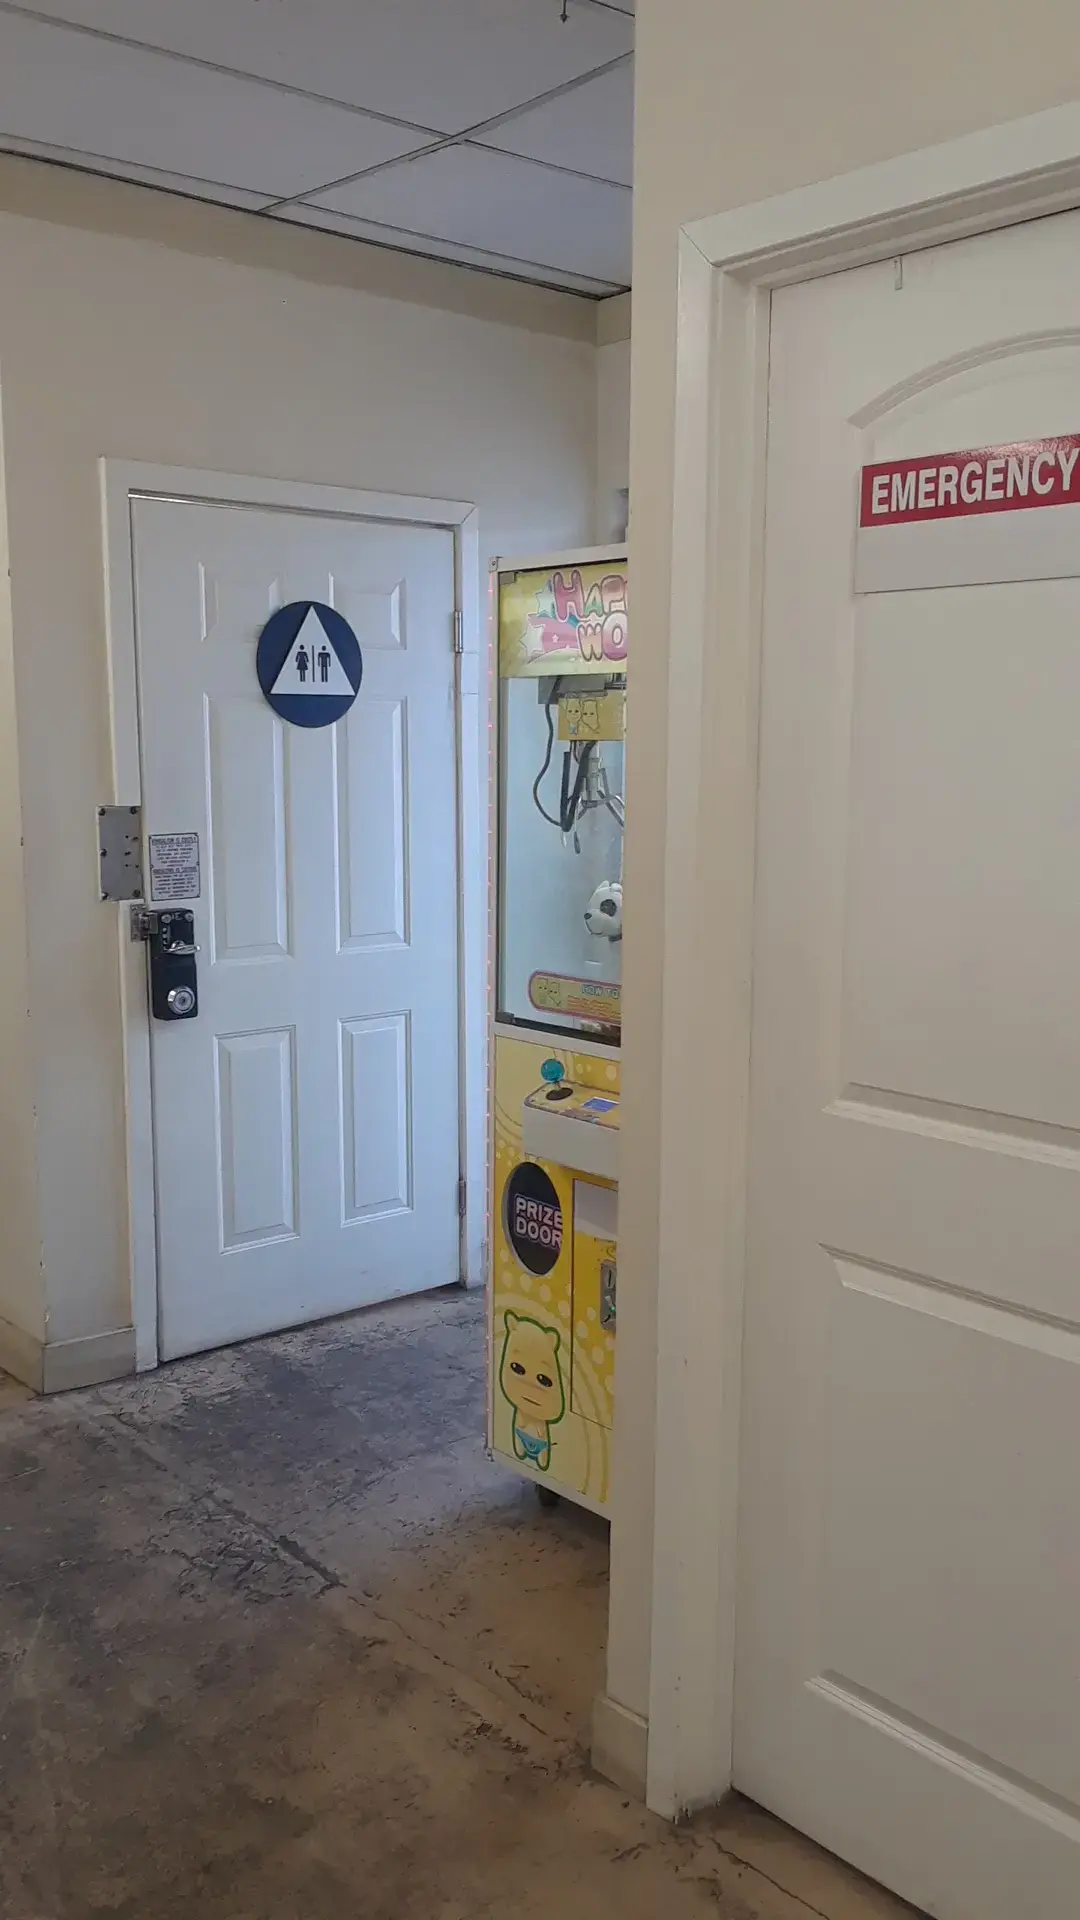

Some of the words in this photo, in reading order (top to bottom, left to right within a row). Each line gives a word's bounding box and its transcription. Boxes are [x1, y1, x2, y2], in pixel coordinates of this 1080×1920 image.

[871, 447, 1080, 515] EMERGENCY
[552, 569, 627, 622] HAP
[577, 611, 627, 662] WO
[516, 1196, 562, 1229] PRIZE
[516, 1217, 563, 1249] DOOR
